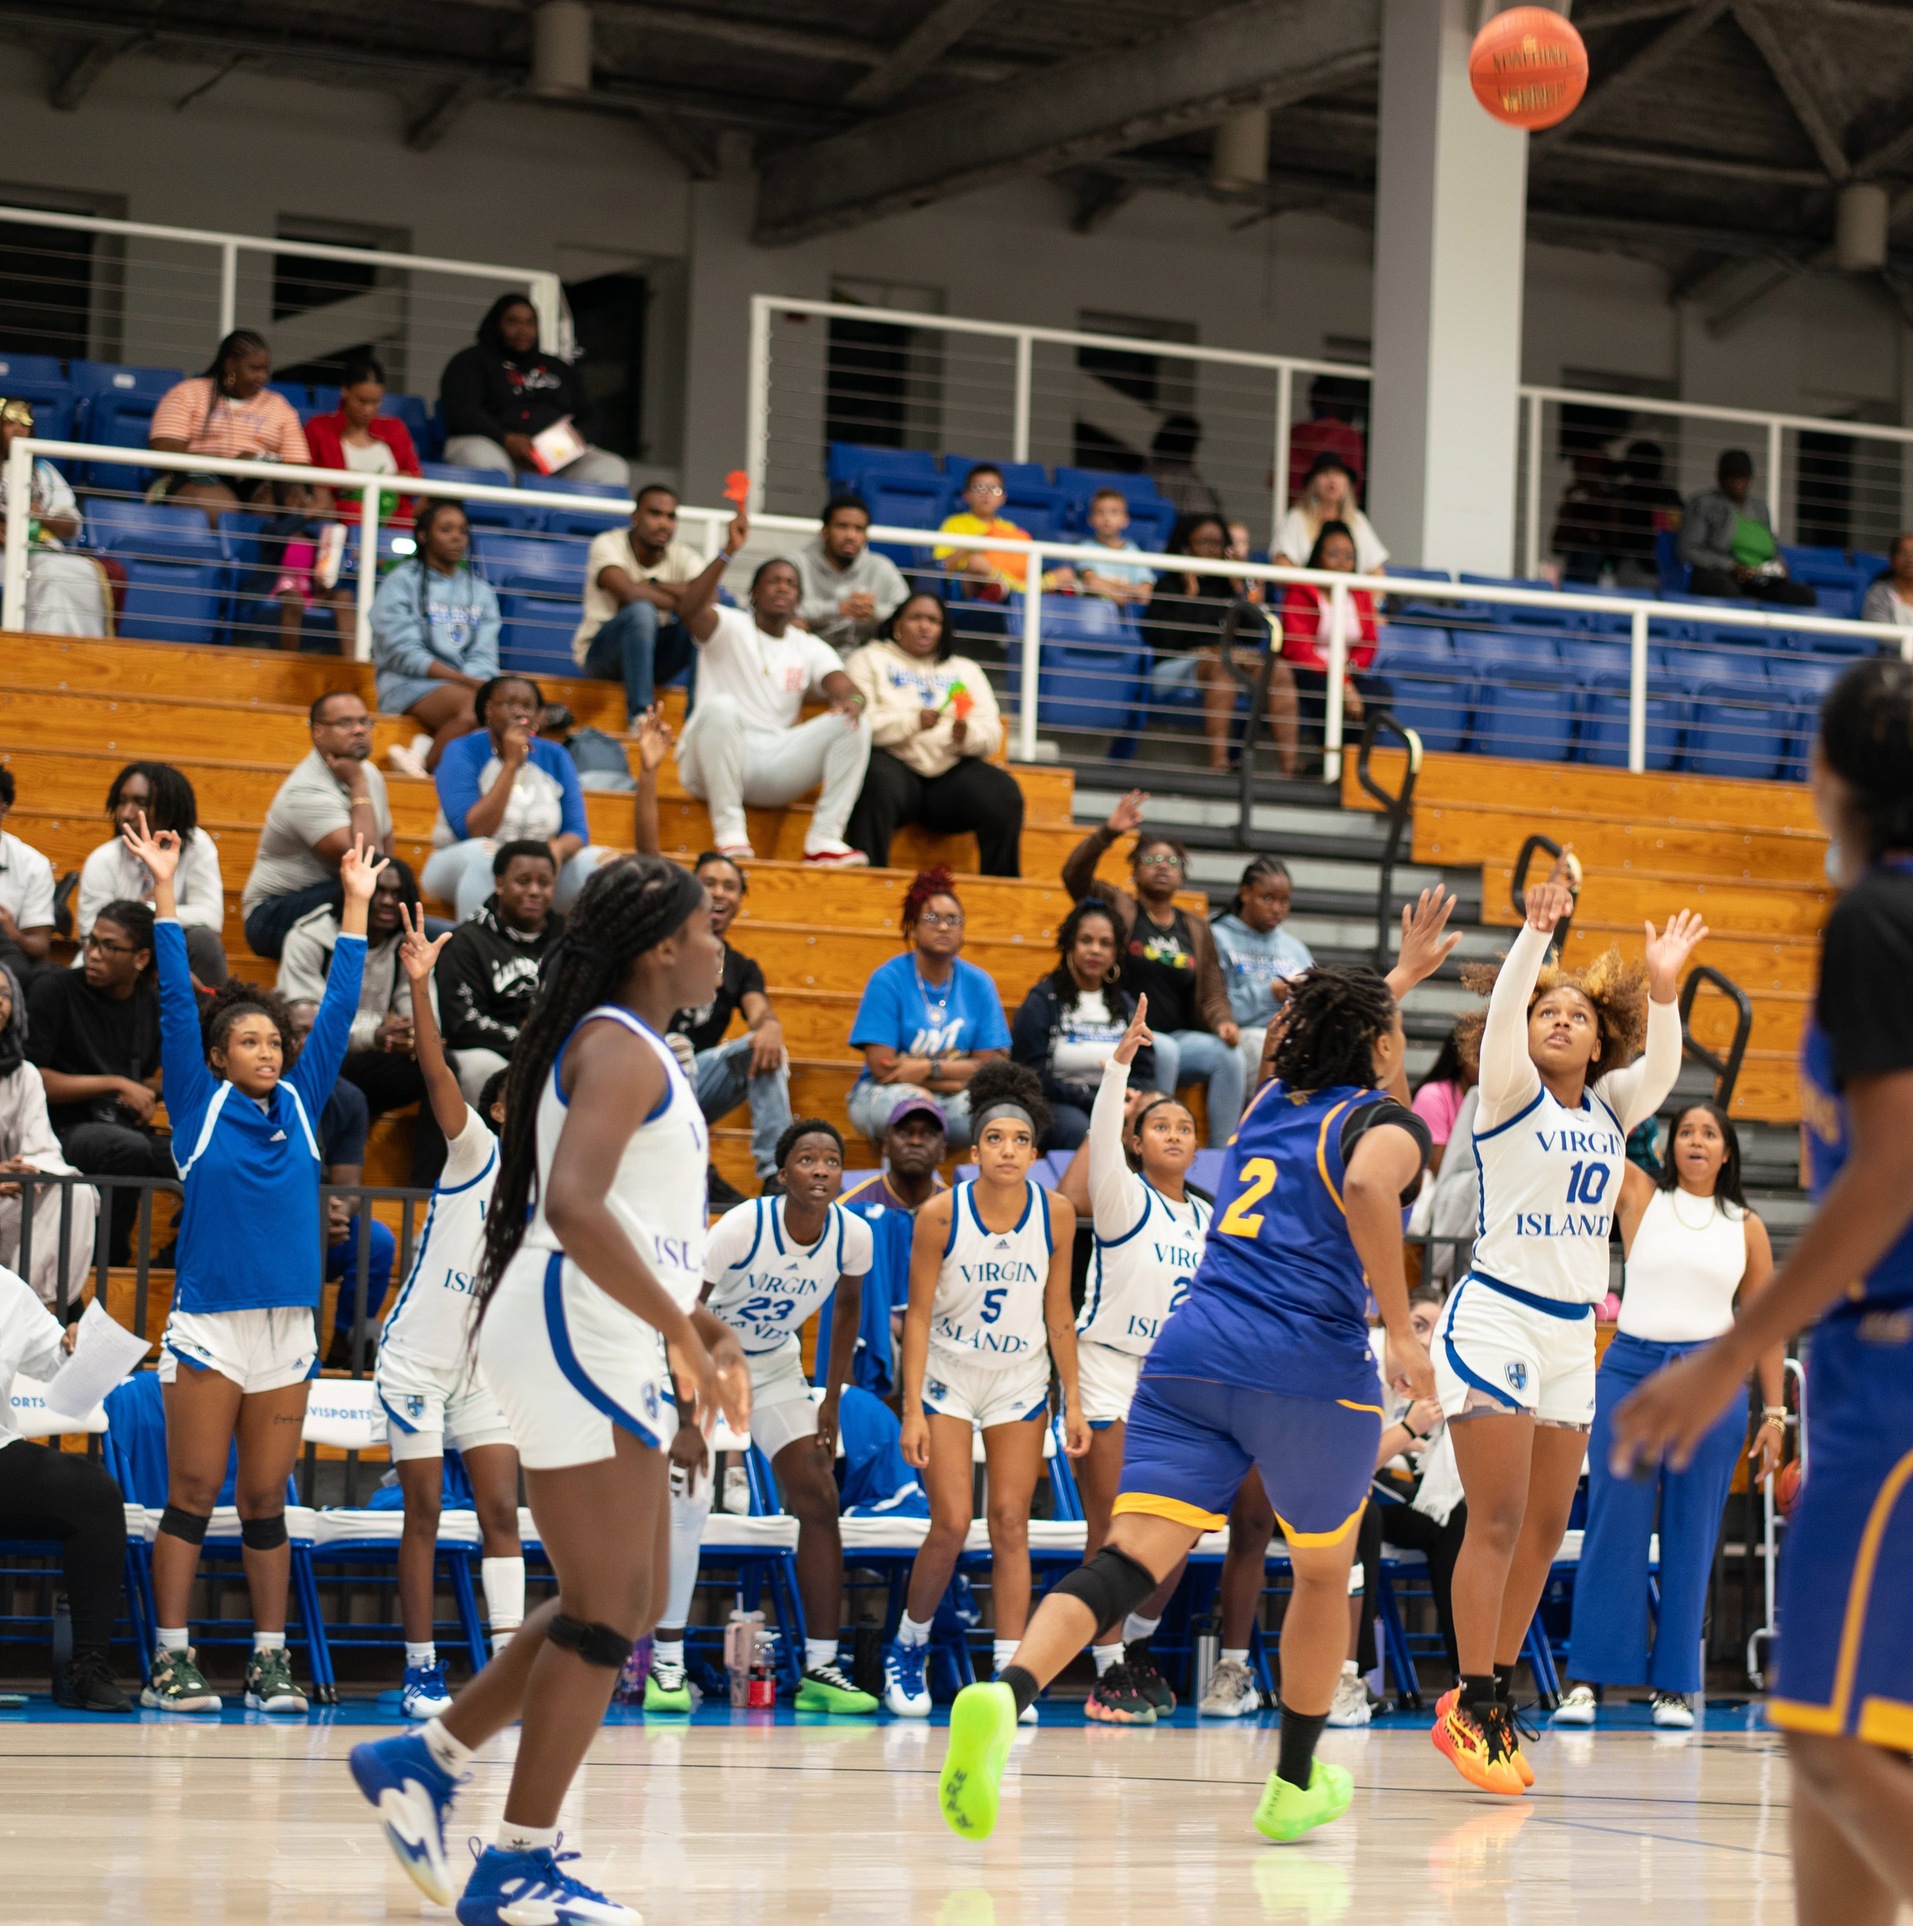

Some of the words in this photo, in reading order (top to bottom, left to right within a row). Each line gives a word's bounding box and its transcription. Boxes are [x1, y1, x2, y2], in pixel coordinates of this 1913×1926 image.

[1566, 1160, 1611, 1205] 10
[1216, 1157, 1278, 1238] 2
[1516, 1212, 1610, 1237] ISLAND
[749, 1272, 823, 1295] VIRGIN
[960, 1261, 1038, 1283] VIRGIN
[737, 1297, 796, 1322] 23
[980, 1288, 1008, 1324] 5
[306, 1406, 374, 1420] VISPORTS
